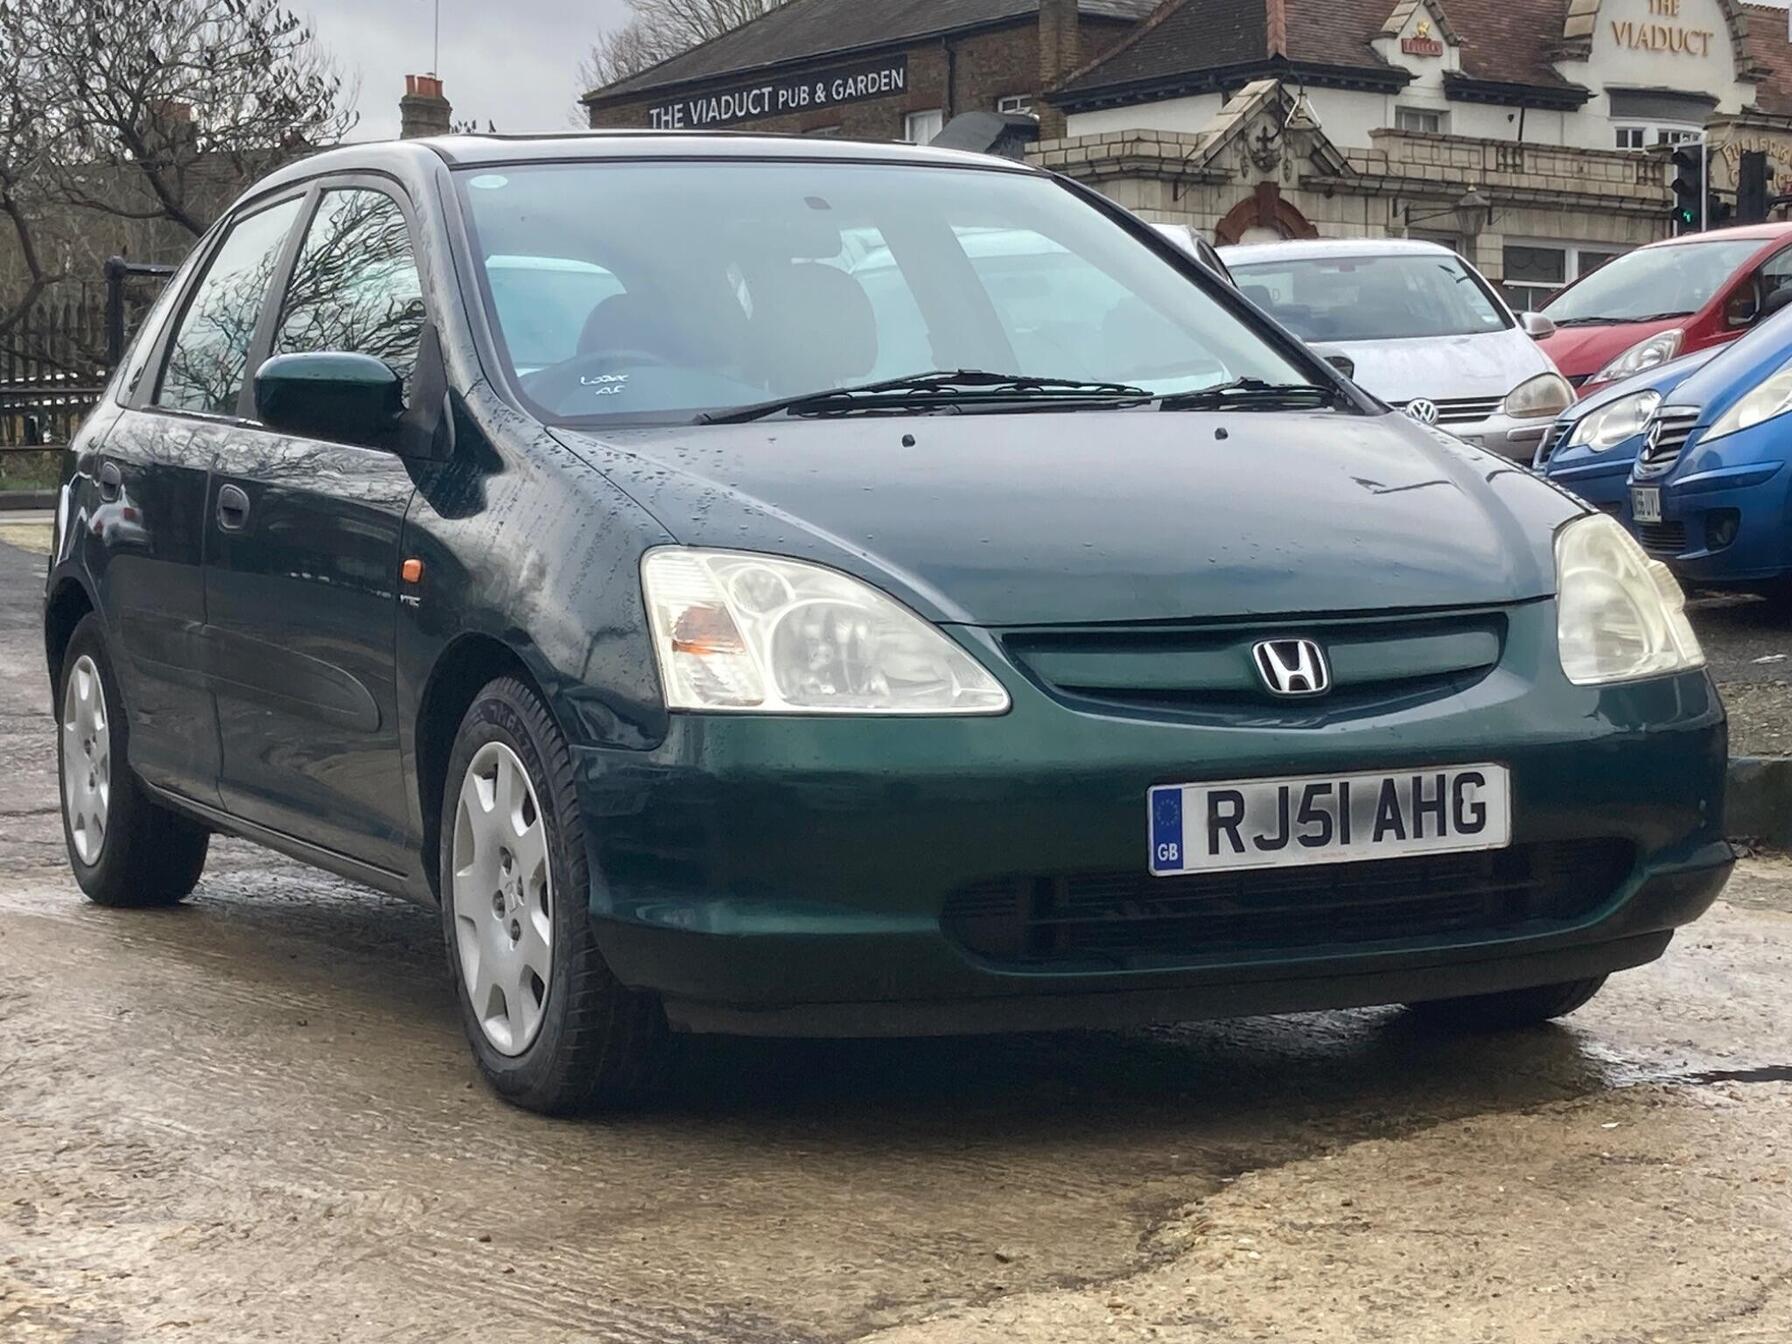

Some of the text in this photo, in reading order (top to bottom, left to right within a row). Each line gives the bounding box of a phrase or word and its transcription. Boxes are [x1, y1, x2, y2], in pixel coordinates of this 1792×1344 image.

[1611, 21, 1715, 57] VIADUCT
[650, 68, 904, 129] THE VIADUCT PUB & GARDEN
[1207, 771, 1487, 856] RJ51 AHG
[1157, 842, 1179, 862] GB
